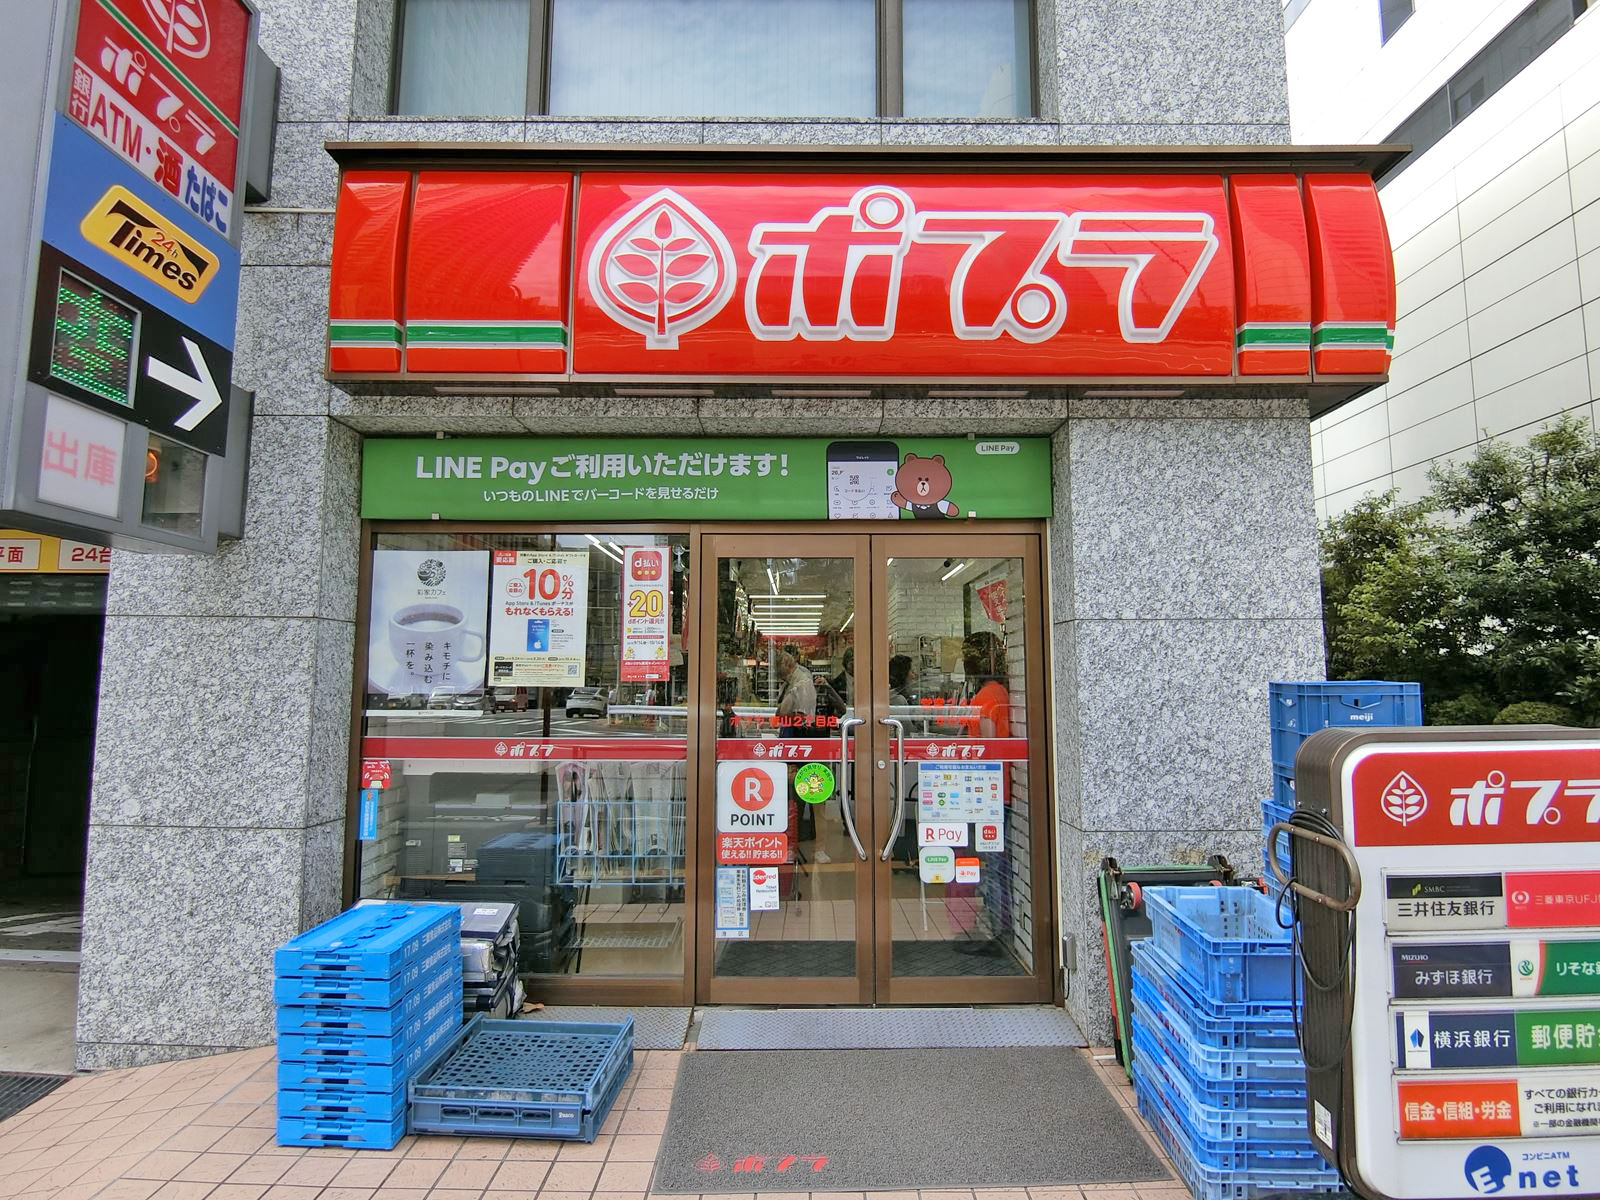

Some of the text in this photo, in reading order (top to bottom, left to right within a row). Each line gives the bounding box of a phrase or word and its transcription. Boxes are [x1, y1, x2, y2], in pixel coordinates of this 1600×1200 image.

[101, 36, 216, 155] ポプラ
[71, 69, 91, 121] 銀行
[185, 165, 229, 234] たばこ
[107, 199, 209, 290] Times
[746, 185, 1219, 344] ポプラ
[42, 431, 118, 486] 出庫
[416, 456, 483, 479] LINE
[0, 546, 24, 562] 面
[634, 558, 659, 568] d払い
[523, 569, 574, 600] 10 % 分
[505, 607, 574, 616] もれなくもらえる!
[424, 642, 434, 684] 染み込む
[442, 642, 452, 681] キモチに
[1350, 713, 1373, 722] meiji
[510, 742, 555, 756] ポプラ
[768, 742, 813, 758] ポプラ
[941, 743, 986, 757] ポプラ
[744, 777, 764, 802] R
[730, 814, 775, 826] POINT
[721, 836, 782, 848] 楽天ポイント
[938, 828, 963, 842] Pay
[1424, 885, 1446, 893] SMBC
[1535, 894, 1600, 905] 三菱東京UFJ
[1397, 900, 1495, 917] 三井住友銀行
[1415, 969, 1493, 985] みずほ銀行
[1433, 1029, 1511, 1049] 横浜銀行
[1531, 1023, 1600, 1049] 郵便貯
[1524, 1087, 1600, 1100] すべての銀行カ
[1404, 1101, 1512, 1121] 信金・信組・労金
[1534, 1101, 1600, 1114] ご利用になれ
[1522, 1151, 1570, 1161] コンビニATM
[1519, 1165, 1579, 1188] net
